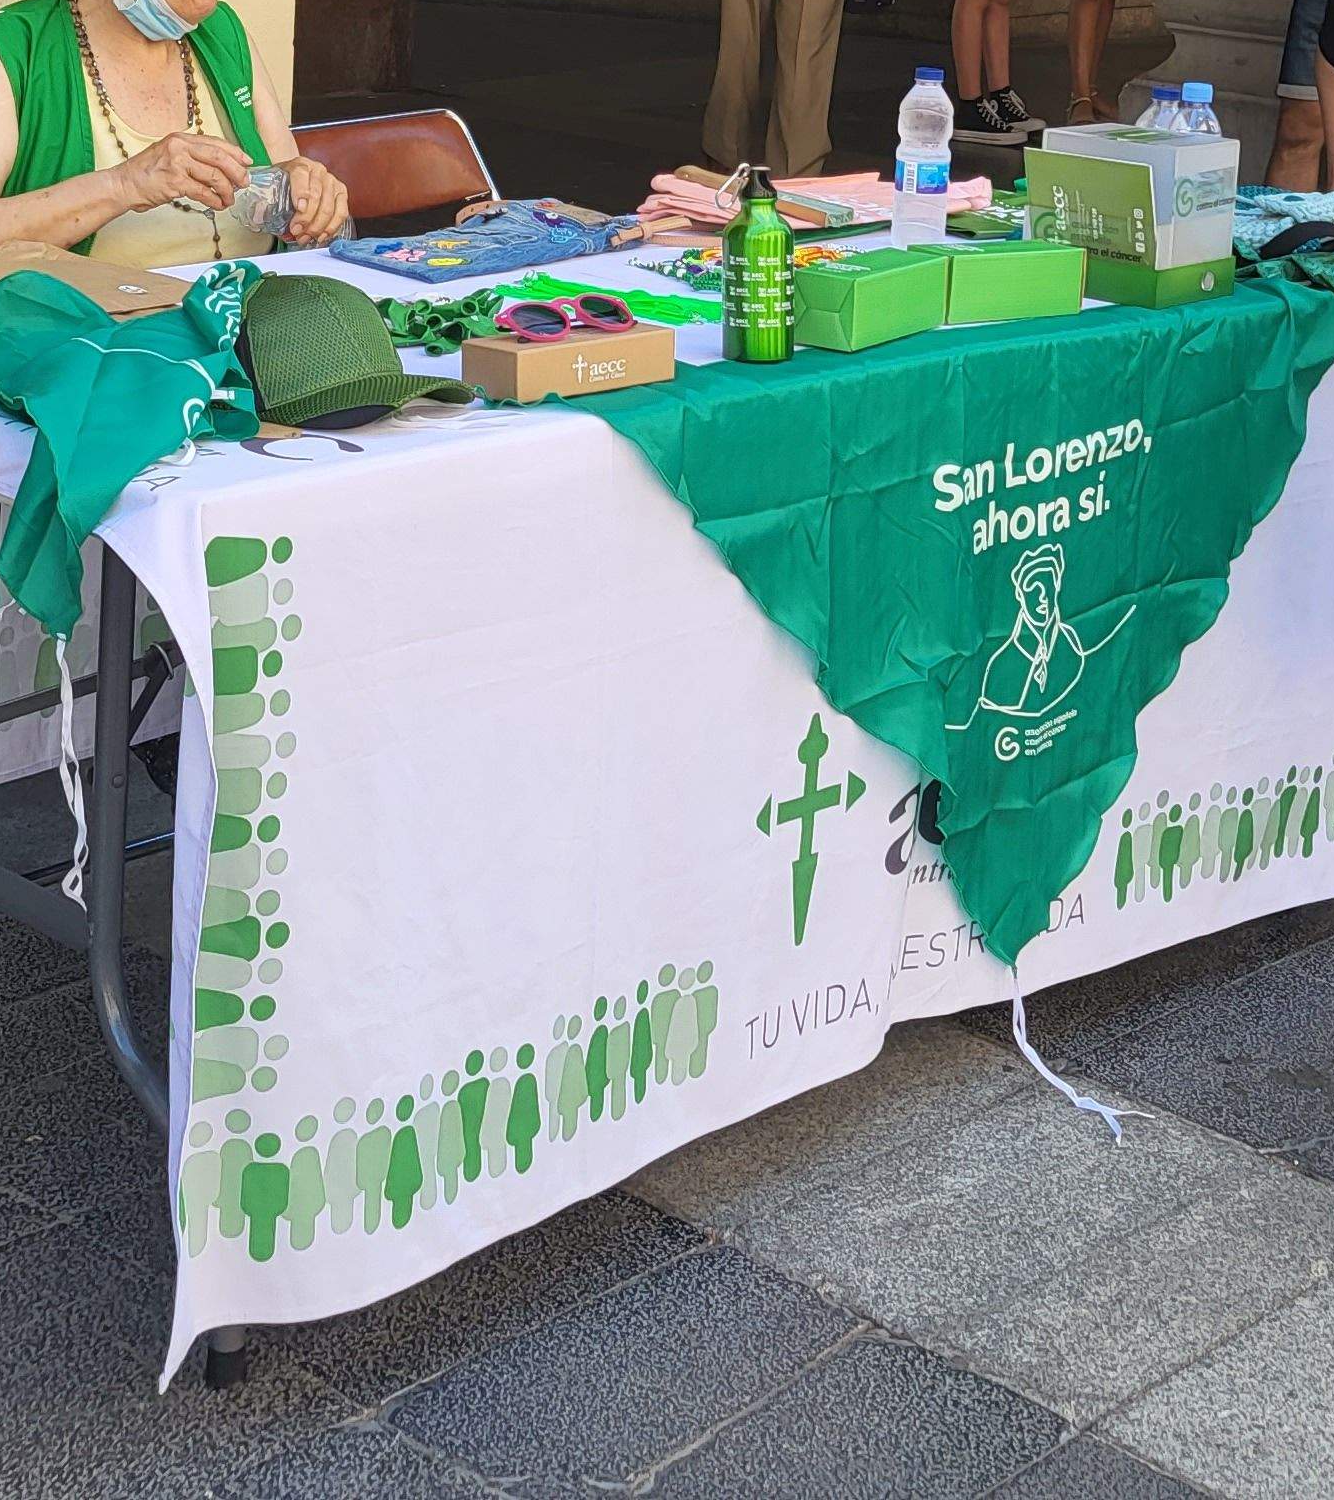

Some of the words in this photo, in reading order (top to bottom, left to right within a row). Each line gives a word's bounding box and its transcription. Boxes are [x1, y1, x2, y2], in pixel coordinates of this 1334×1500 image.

[589, 358, 627, 376] aecc
[932, 460, 995, 513] San
[1004, 417, 1153, 489] Lorenzo,
[972, 496, 1071, 555] ahora
[744, 1004, 782, 1060] TU
[791, 977, 880, 1036] VIDA,
